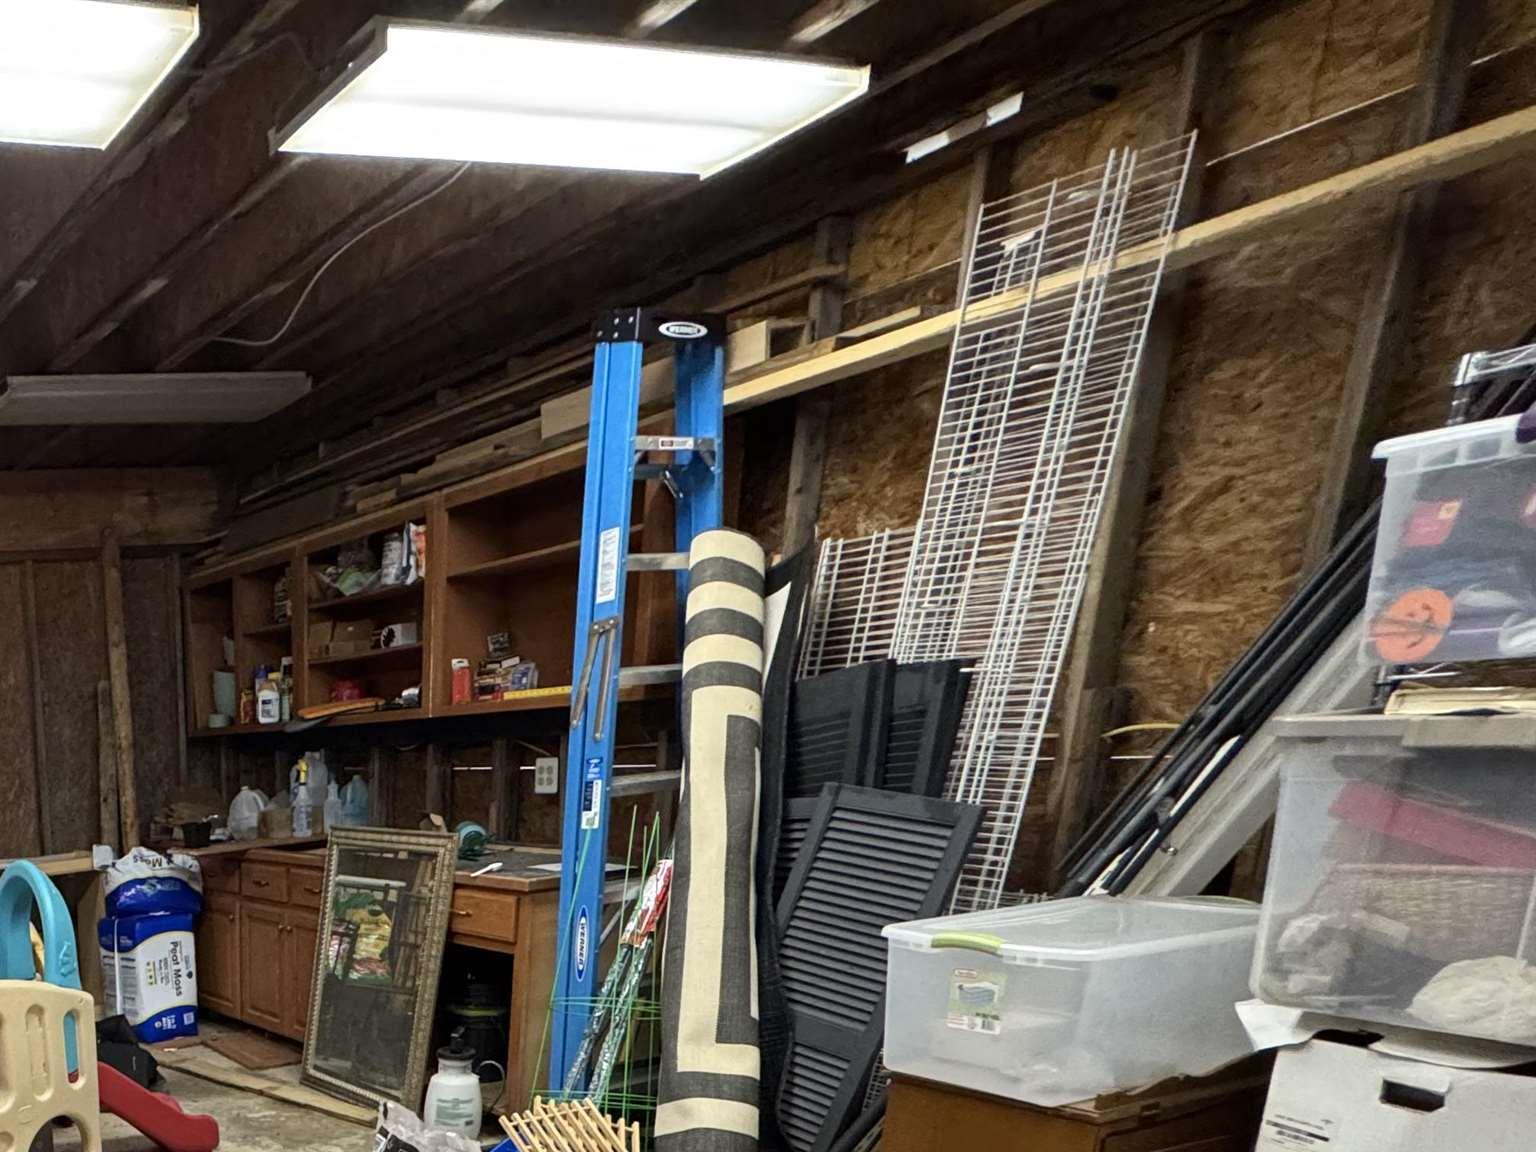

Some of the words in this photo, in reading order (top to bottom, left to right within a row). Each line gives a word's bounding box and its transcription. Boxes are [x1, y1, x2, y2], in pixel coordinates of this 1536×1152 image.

[169, 940, 181, 966] Peat
[578, 922, 587, 966] WERNER
[173, 968, 184, 997] Moss
